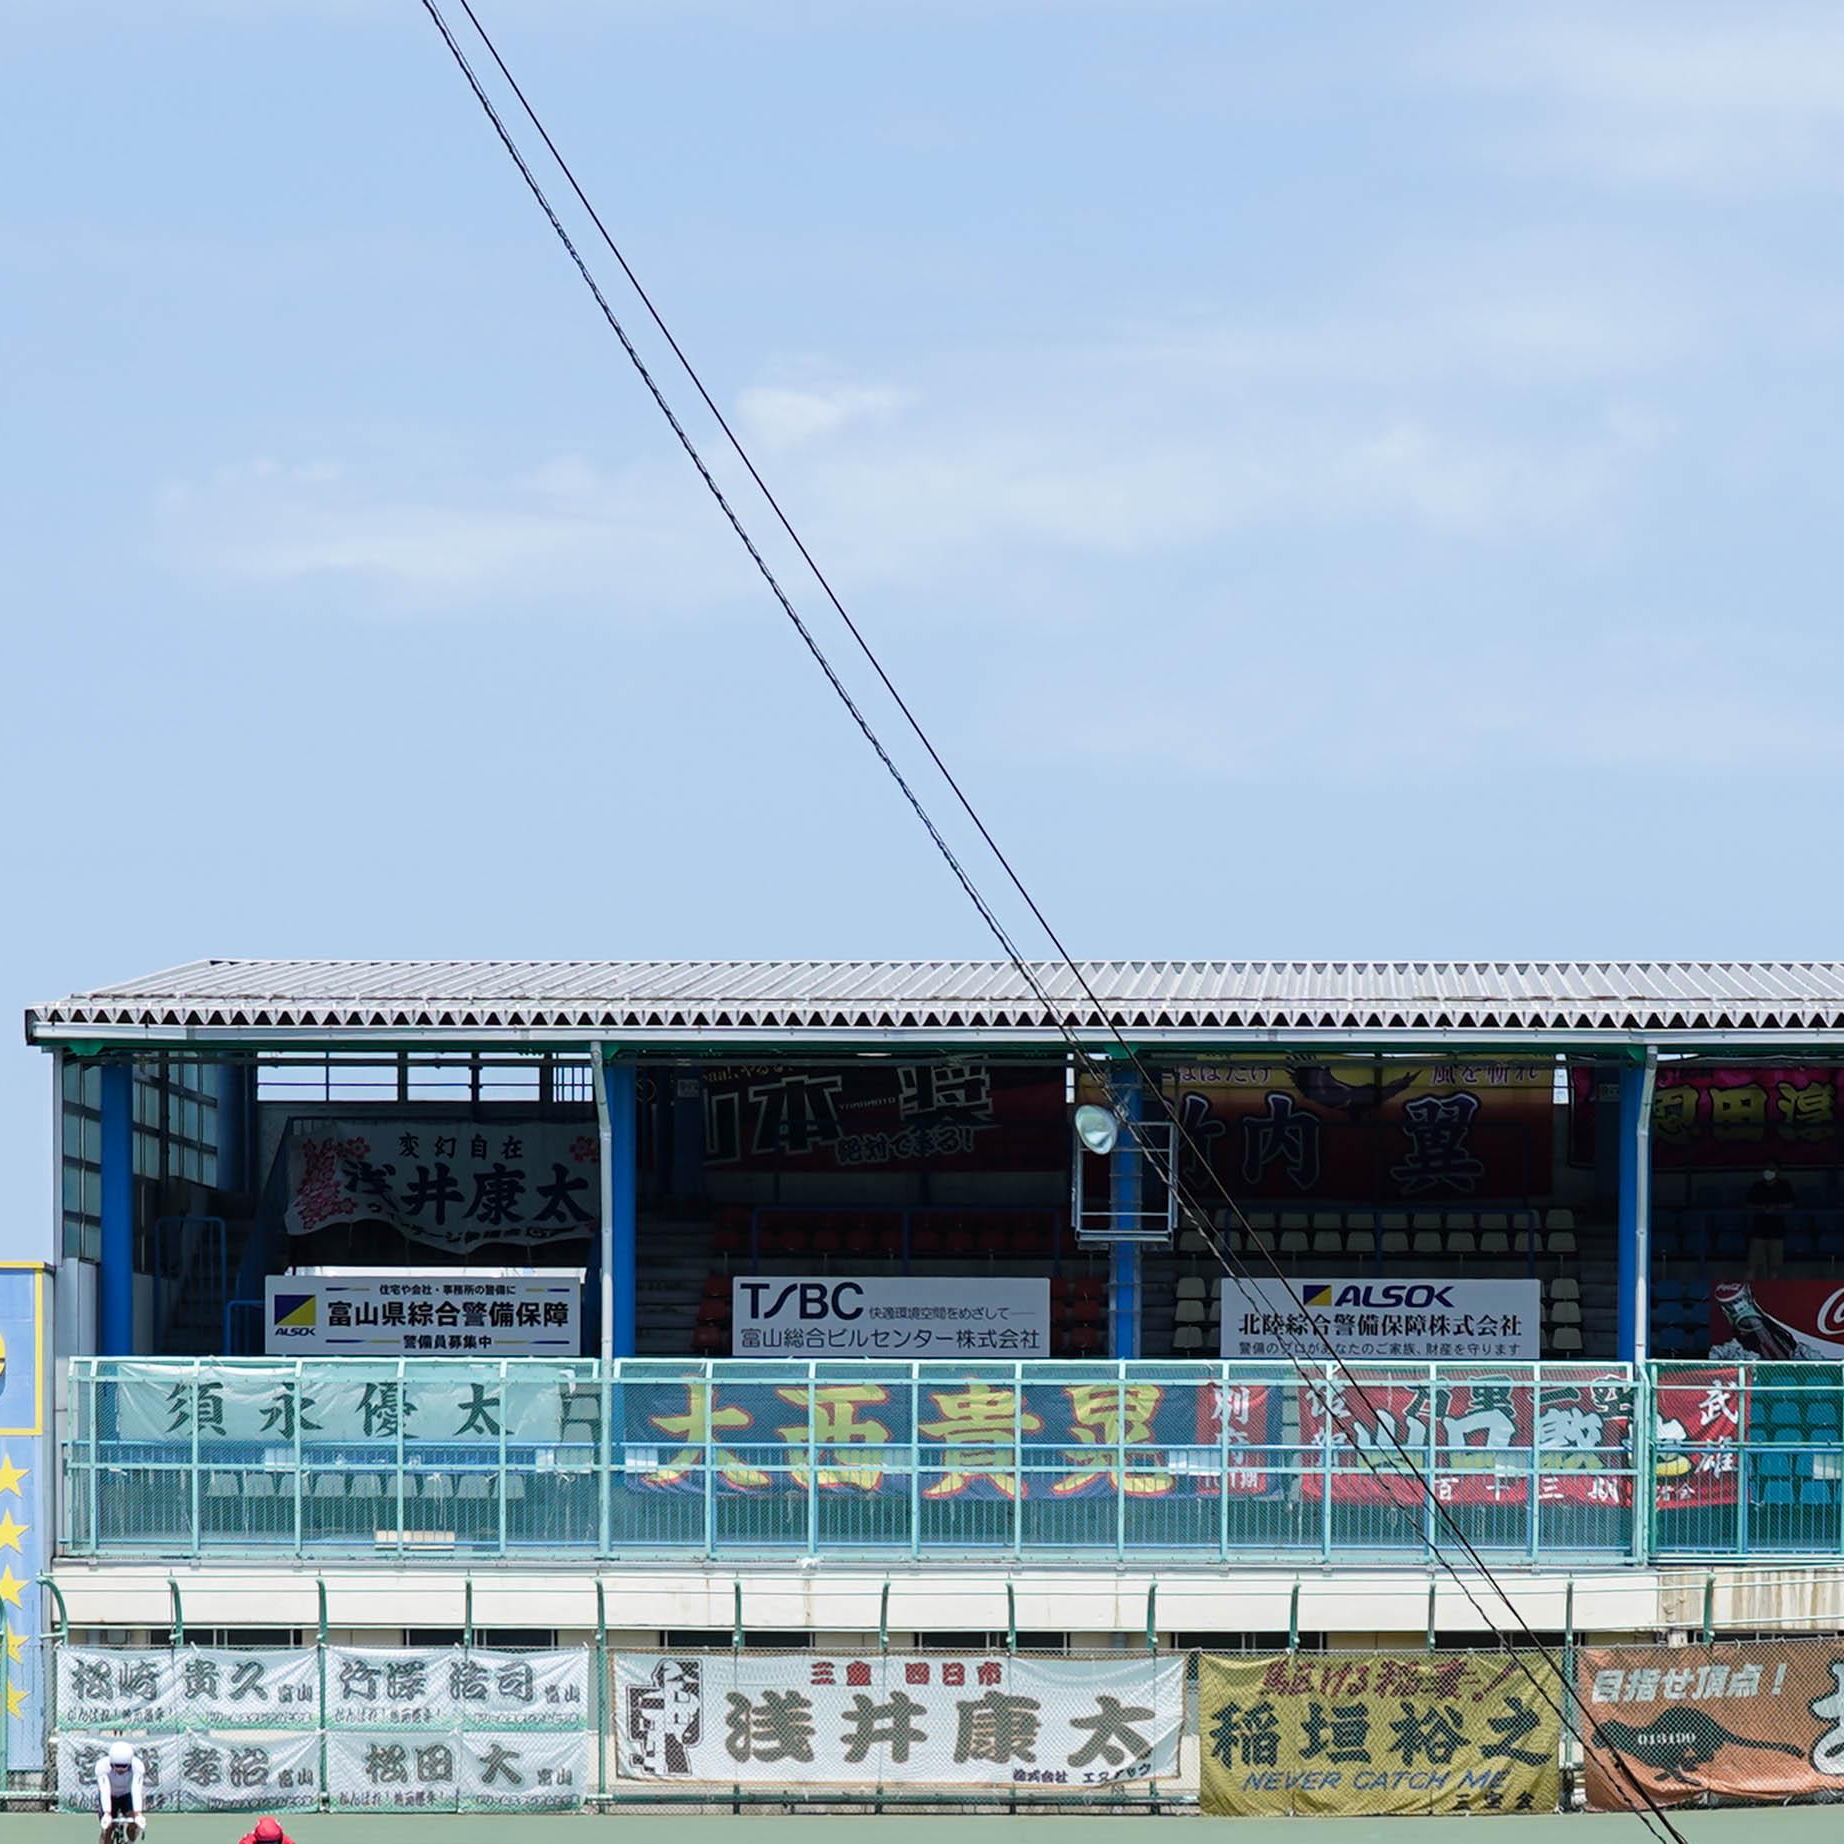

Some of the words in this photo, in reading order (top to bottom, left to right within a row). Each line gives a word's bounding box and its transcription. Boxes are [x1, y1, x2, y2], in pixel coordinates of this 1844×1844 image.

[398, 1131, 524, 1161] 変幻自在
[342, 1159, 595, 1226] 浅井康太
[1335, 1285, 1455, 1308] ALSOK
[328, 1301, 569, 1328] 富山県綜合警備保障
[1238, 1313, 1523, 1338] 北陸綜合警備保障株式会社
[274, 1328, 316, 1337] ALSOK
[403, 1335, 493, 1350] 警備員募集中
[740, 1328, 1041, 1350] 富山総合ビルセンター株式会社
[165, 1381, 514, 1440] 須永優太
[643, 1376, 1175, 1499] 大西貴晃
[809, 1661, 873, 1686] 三重
[904, 1660, 1003, 1686] 四日市
[1591, 1662, 1788, 1705] 目指せ頂点！
[278, 1684, 313, 1704] 富山
[544, 1683, 581, 1704] 富山
[724, 1689, 1156, 1769] 浅井康太
[1209, 1696, 1551, 1768] 稲垣裕之
[278, 1769, 315, 1788] 富山
[537, 1767, 574, 1786] 富山
[1242, 1770, 1343, 1792] NEVER
[1353, 1770, 1453, 1792] CATCH
[1457, 1767, 1512, 1790] ME
